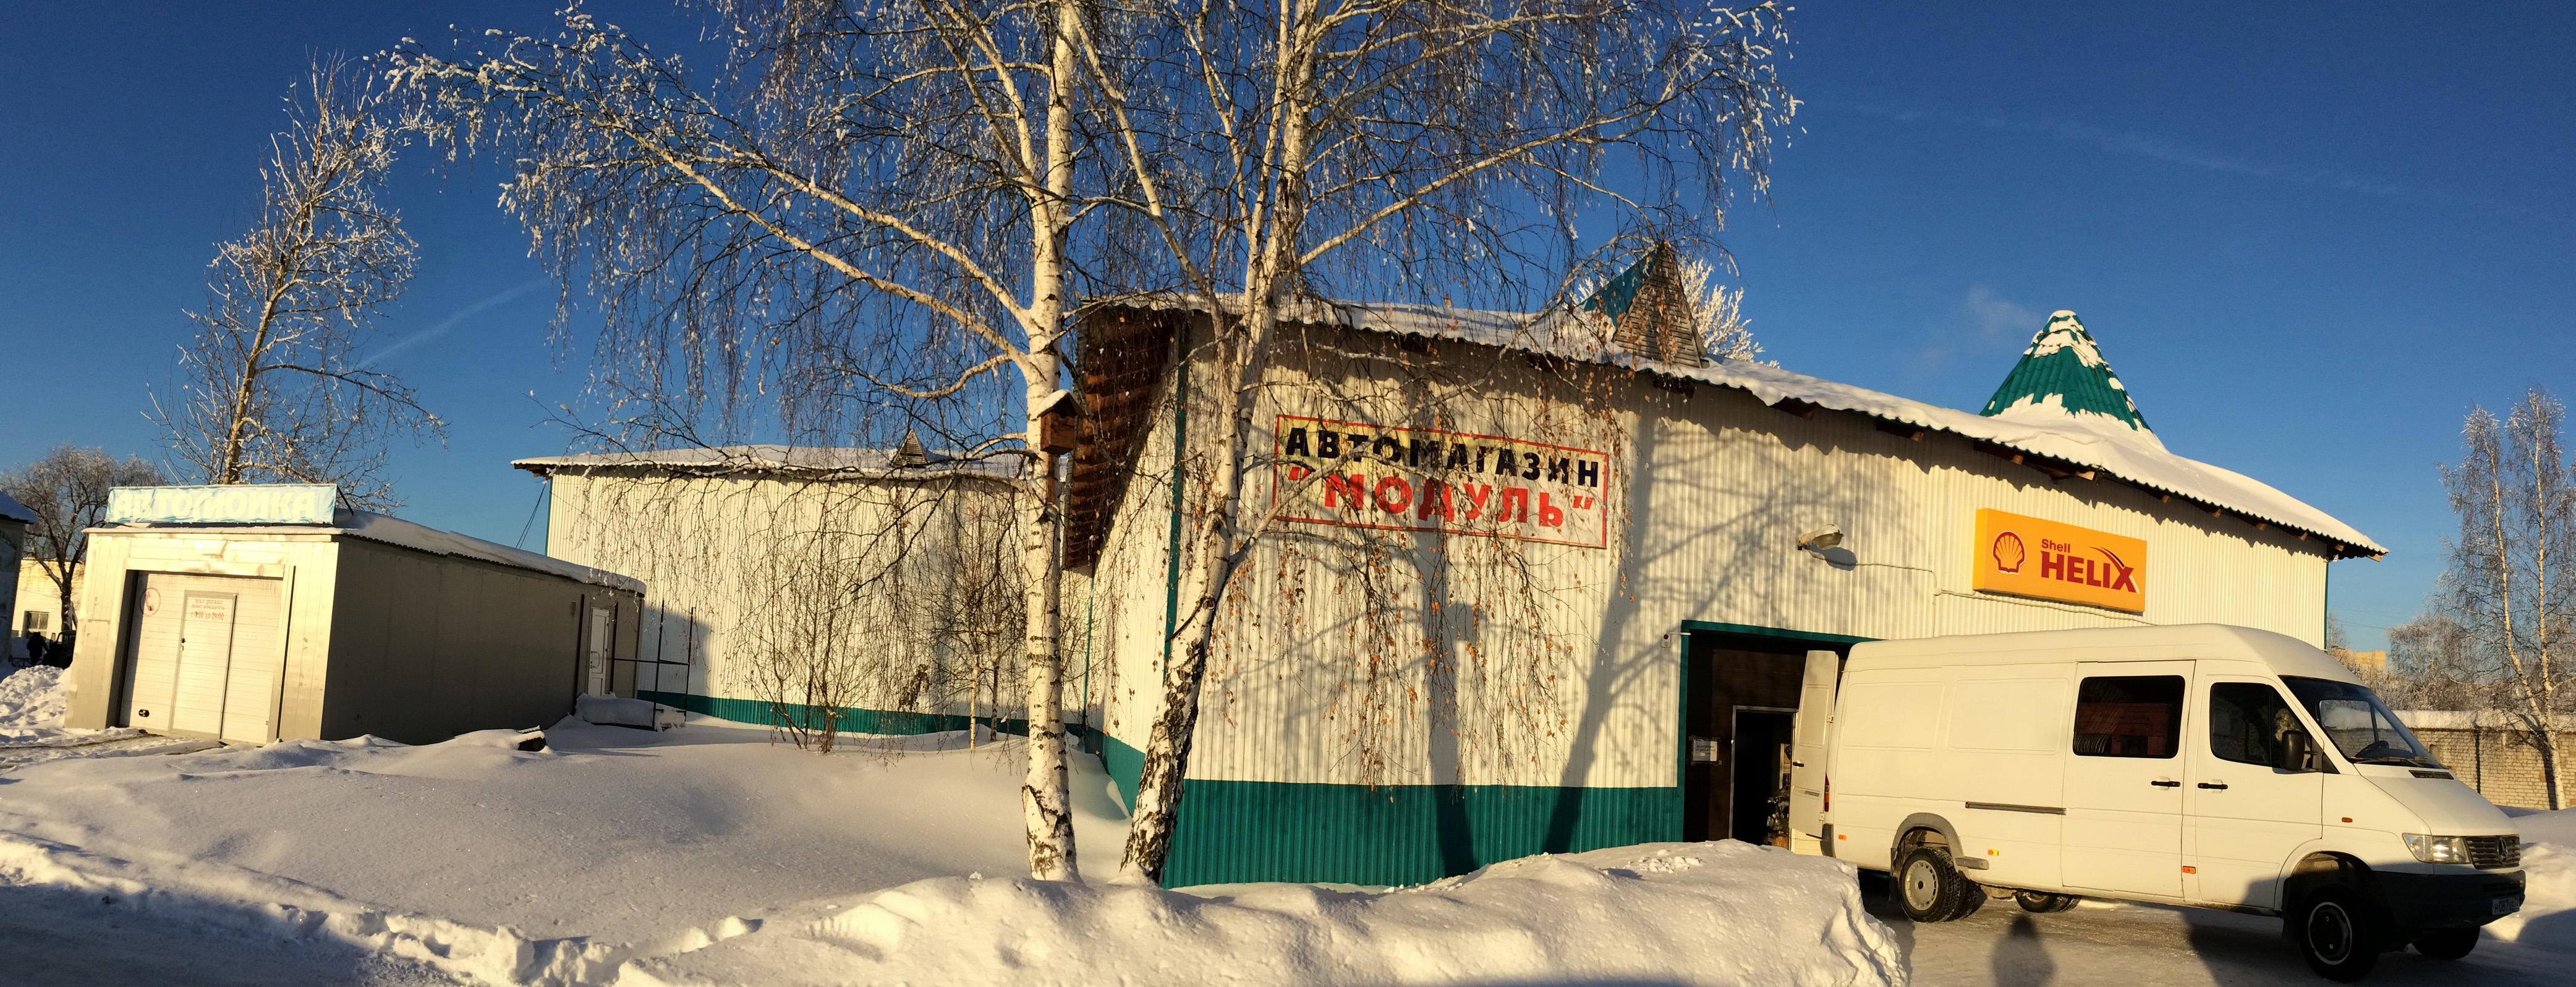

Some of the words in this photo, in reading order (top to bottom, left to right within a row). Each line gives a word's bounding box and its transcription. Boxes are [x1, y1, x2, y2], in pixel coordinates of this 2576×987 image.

[1285, 427, 1599, 487] АВТОМАГАЗИН
[2041, 539, 2070, 553] Shell
[2041, 549, 2138, 594] HELIX
